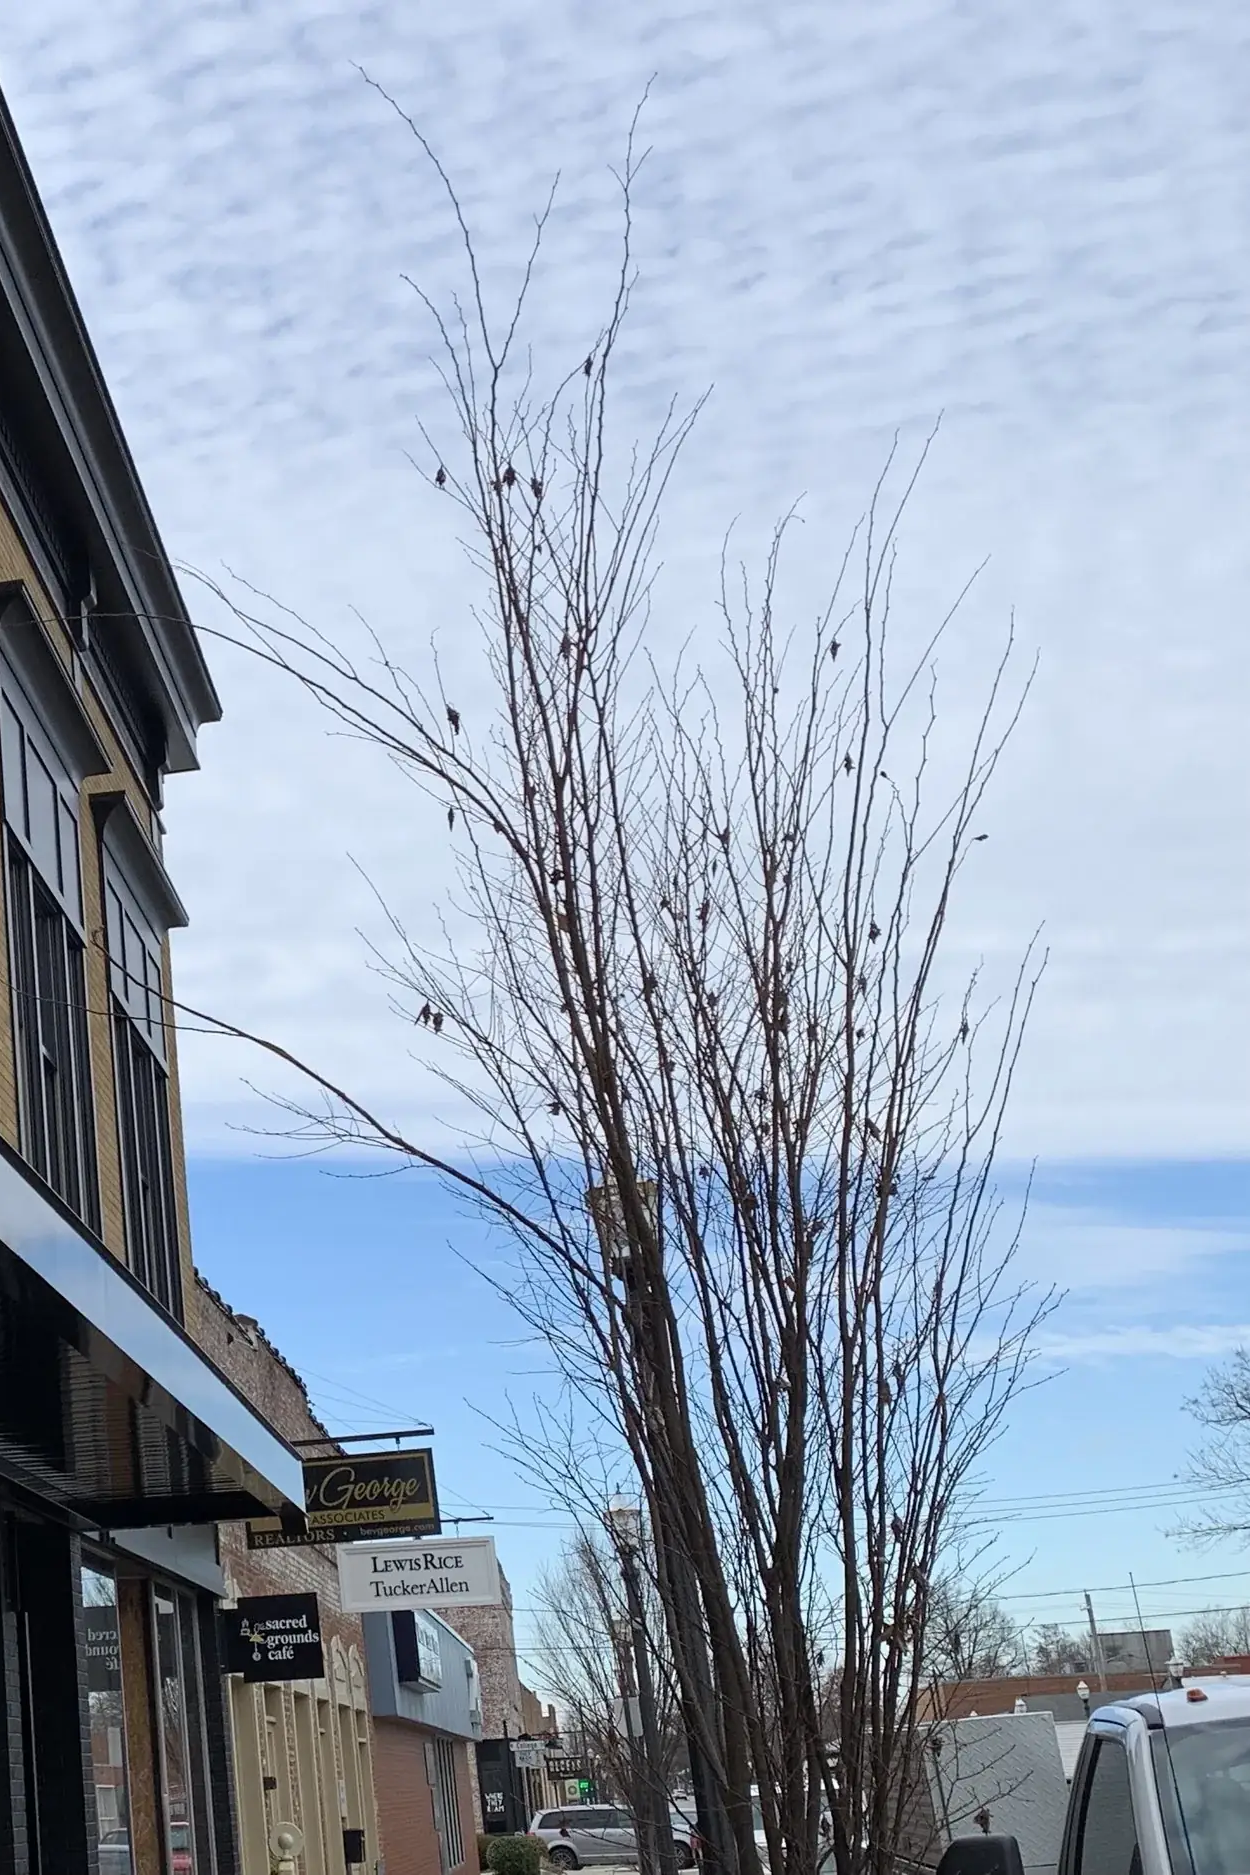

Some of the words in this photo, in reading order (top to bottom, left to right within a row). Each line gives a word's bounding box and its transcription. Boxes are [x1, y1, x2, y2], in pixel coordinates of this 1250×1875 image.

[321, 1467, 419, 1513] George
[312, 1510, 385, 1525] ASSOCIATES
[370, 1577, 470, 1597] TuckerAllen
[265, 1614, 308, 1630] sacred
[266, 1629, 320, 1649] grounds
[267, 1645, 295, 1661] café
